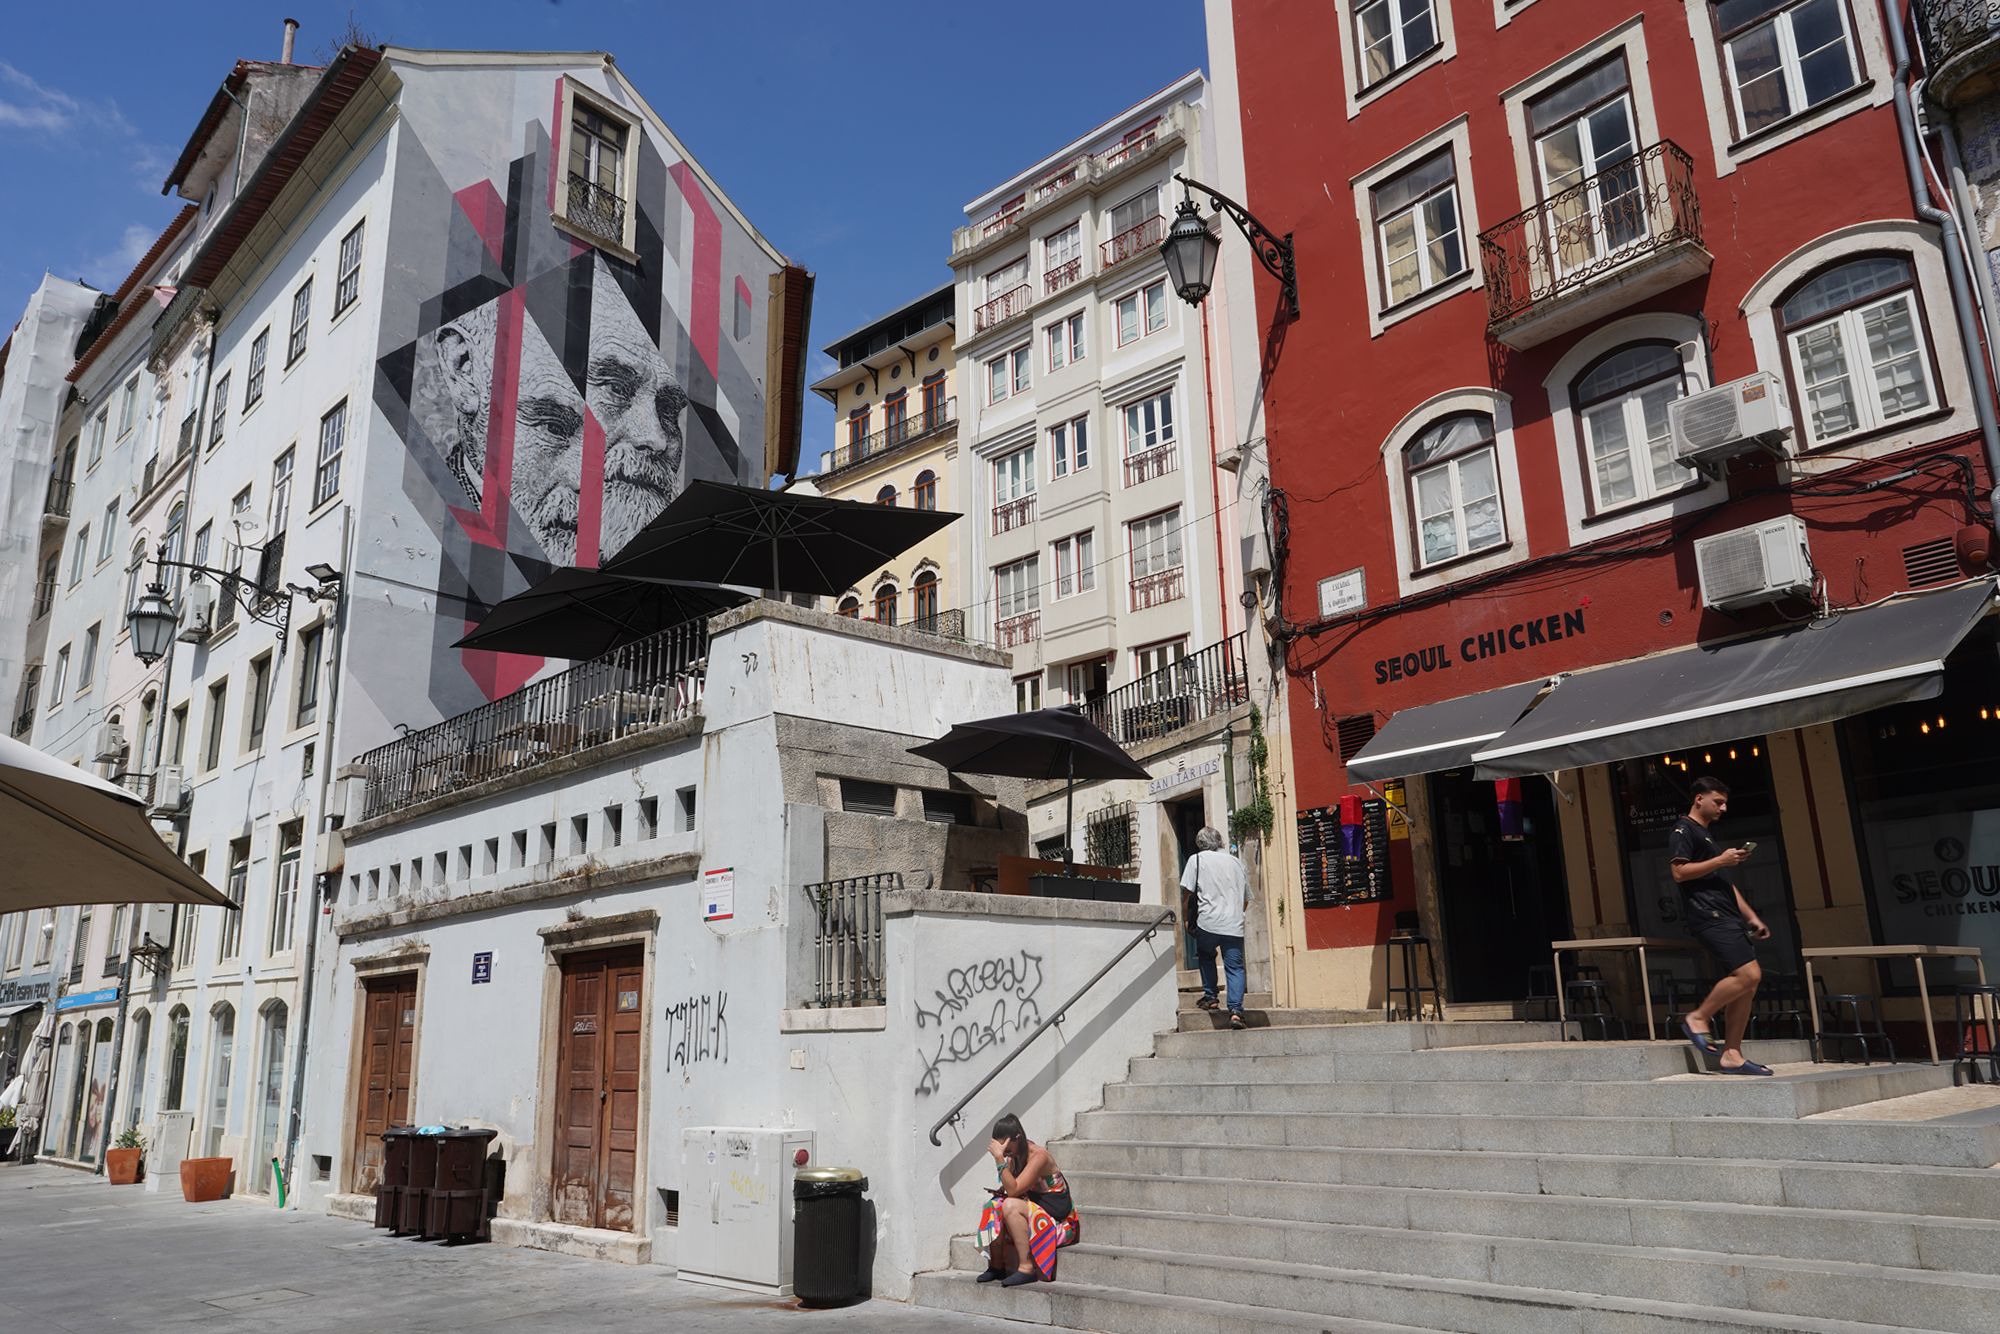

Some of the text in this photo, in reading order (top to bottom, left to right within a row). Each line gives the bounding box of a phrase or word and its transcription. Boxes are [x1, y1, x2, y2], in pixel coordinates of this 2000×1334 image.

[1374, 608, 1585, 685] SEOUL CHICKEN
[1923, 900, 2000, 917] CHICKEN
